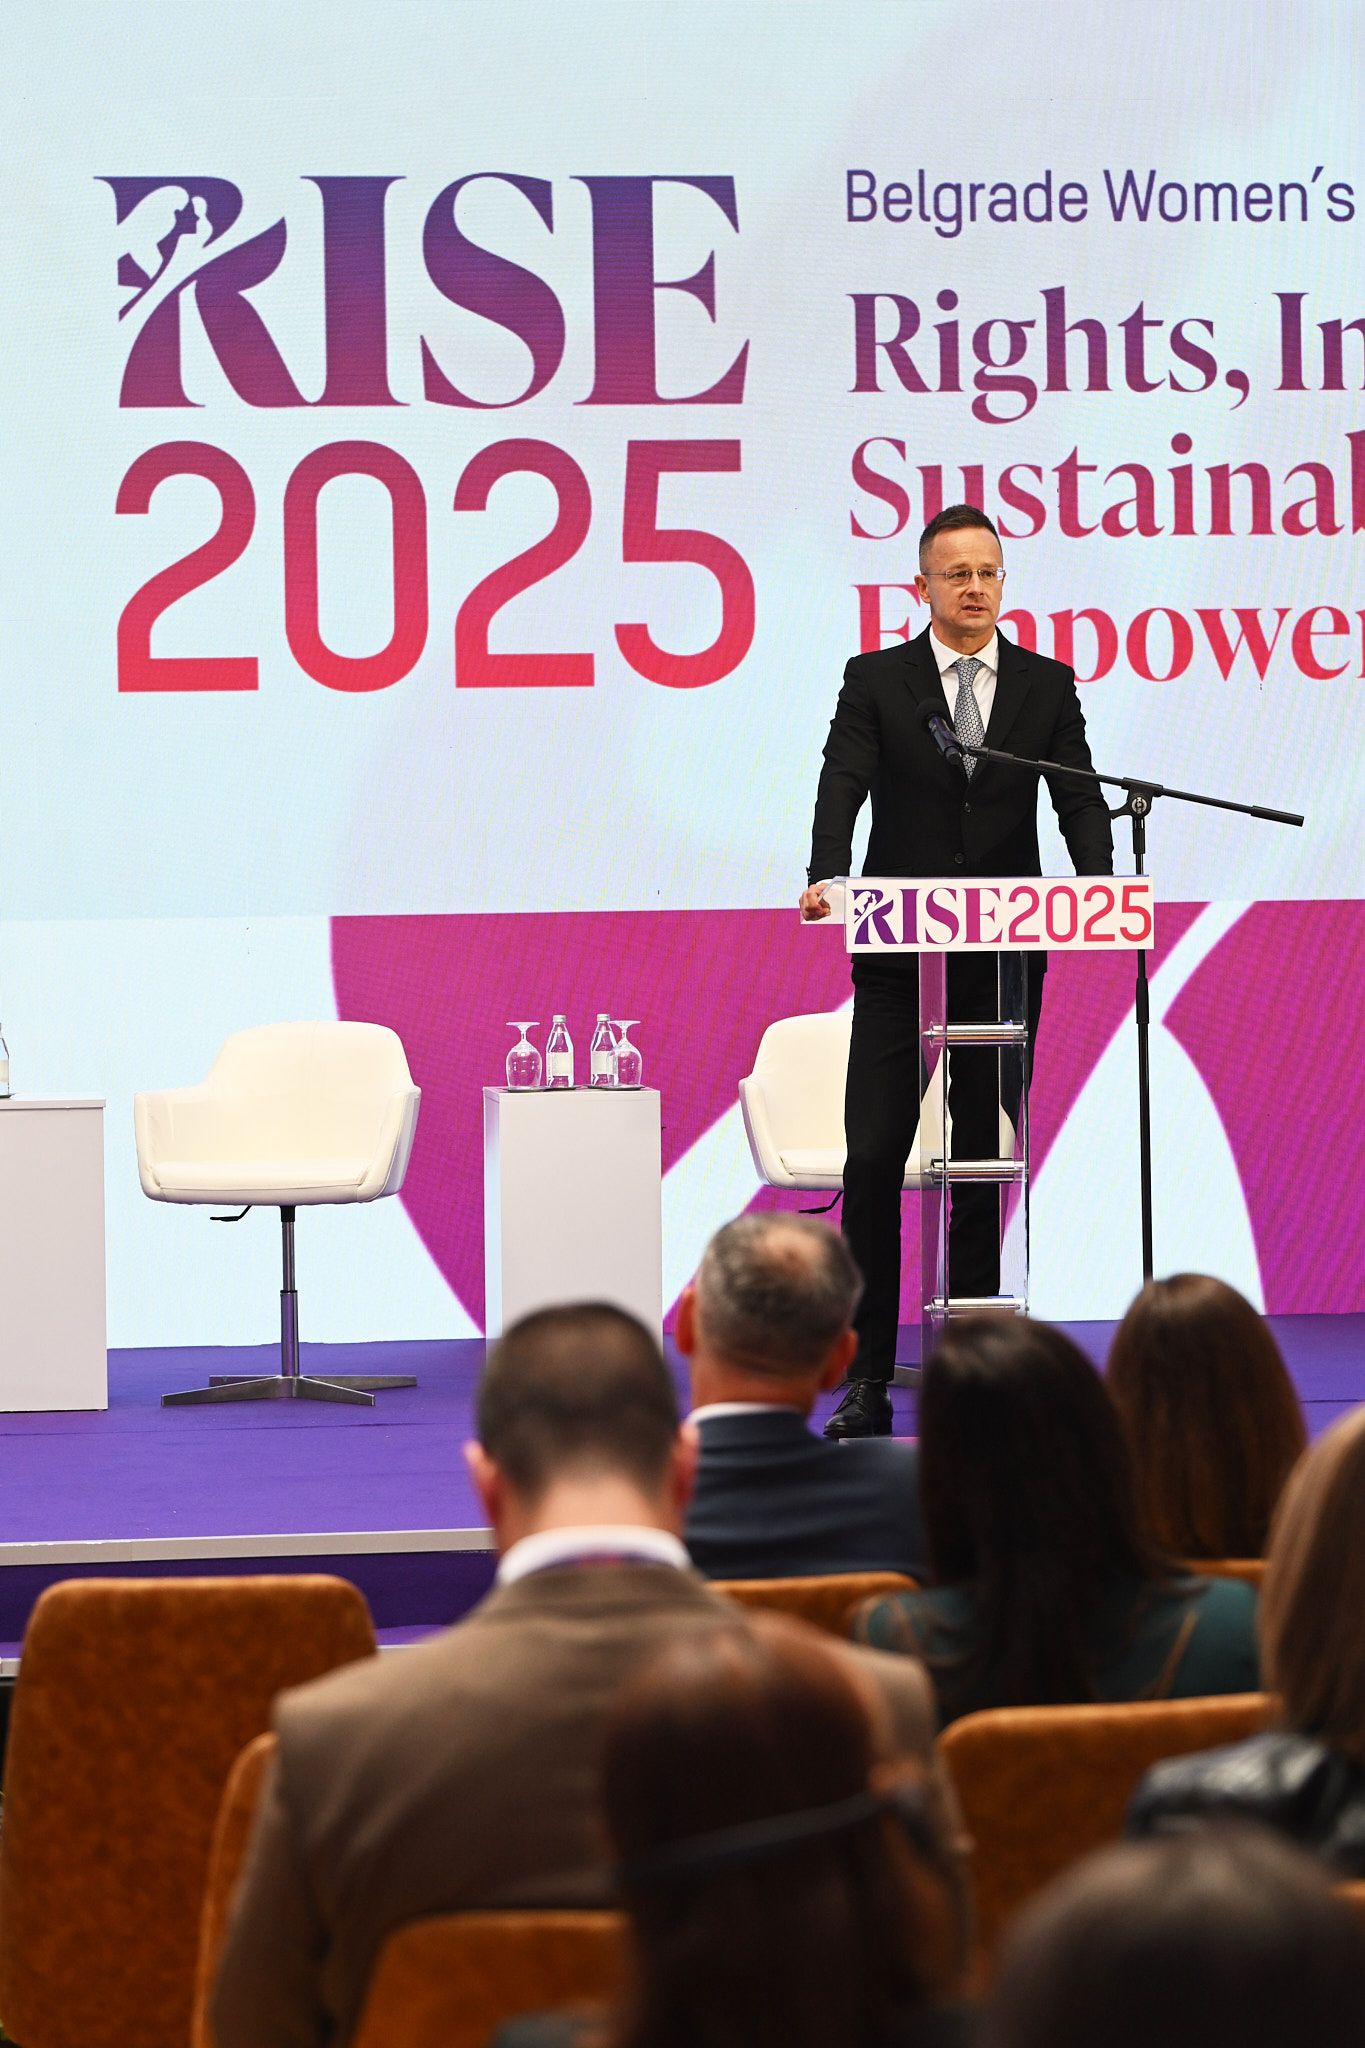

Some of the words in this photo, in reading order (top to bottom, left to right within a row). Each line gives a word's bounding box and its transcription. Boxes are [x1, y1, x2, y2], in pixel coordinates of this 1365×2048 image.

[846, 168, 1089, 238] Belgrade
[1103, 166, 1356, 222] Women's
[93, 172, 750, 410] RISE
[845, 285, 1251, 424] Rights,
[115, 438, 756, 693] 2025
[852, 583, 1365, 683] Epowe
